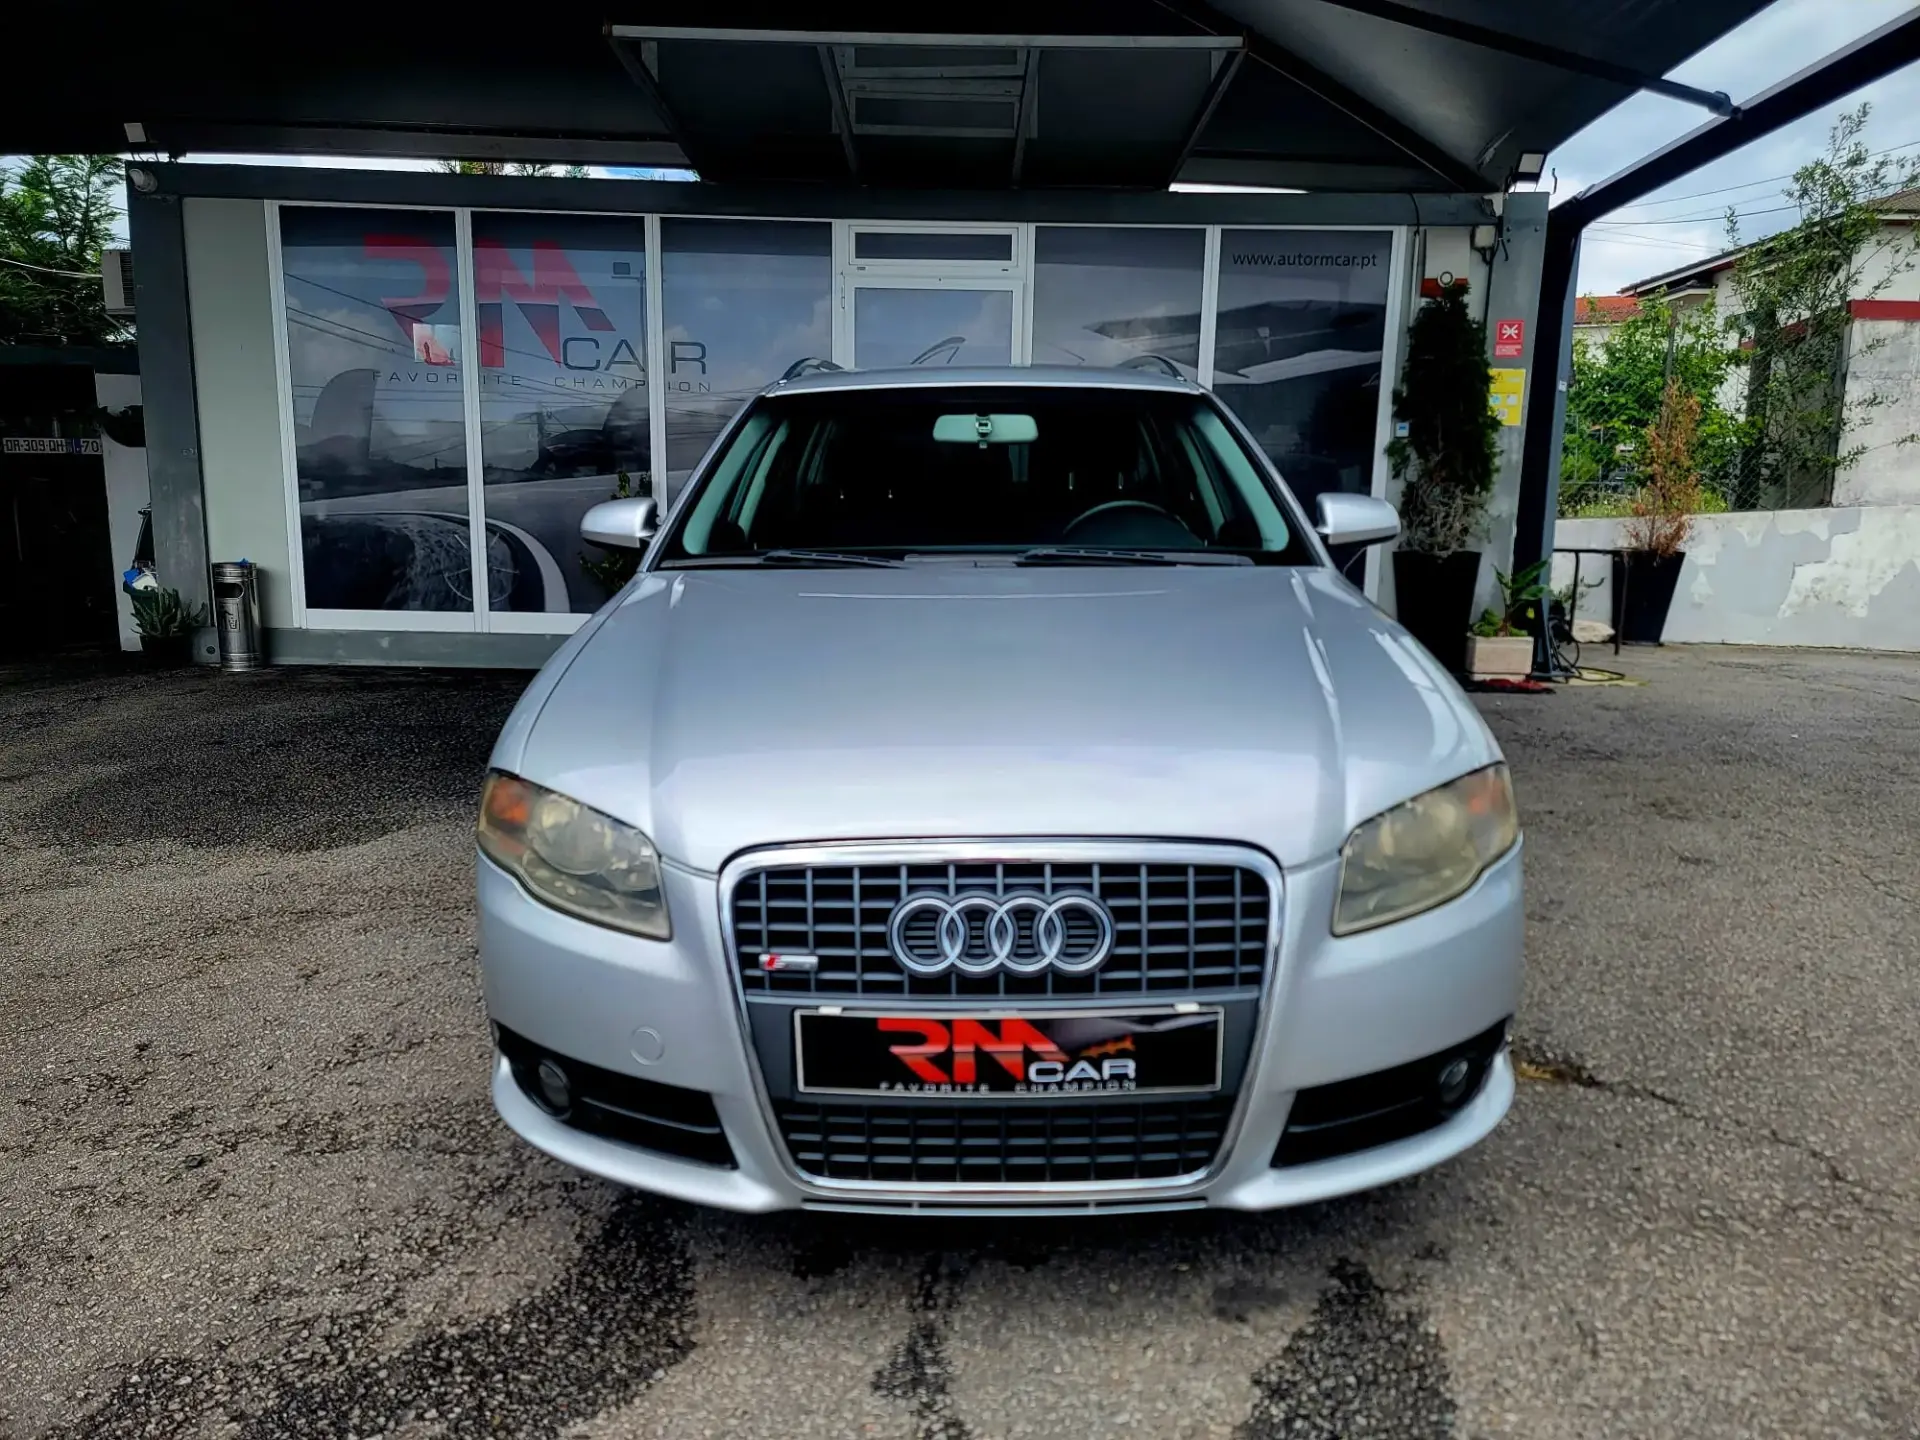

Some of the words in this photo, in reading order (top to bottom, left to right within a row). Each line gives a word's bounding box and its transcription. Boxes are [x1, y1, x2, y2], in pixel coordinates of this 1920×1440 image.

[1232, 252, 1378, 270] www.autormcar.pt
[561, 336, 707, 375] CAR
[372, 370, 522, 387] FAVORITE
[554, 376, 711, 393] CHAMPION
[876, 1017, 1070, 1082] RM
[1027, 1058, 1137, 1083] CAR
[879, 1081, 990, 1095] FAVORITE
[1014, 1079, 1137, 1094] CHAMPION
